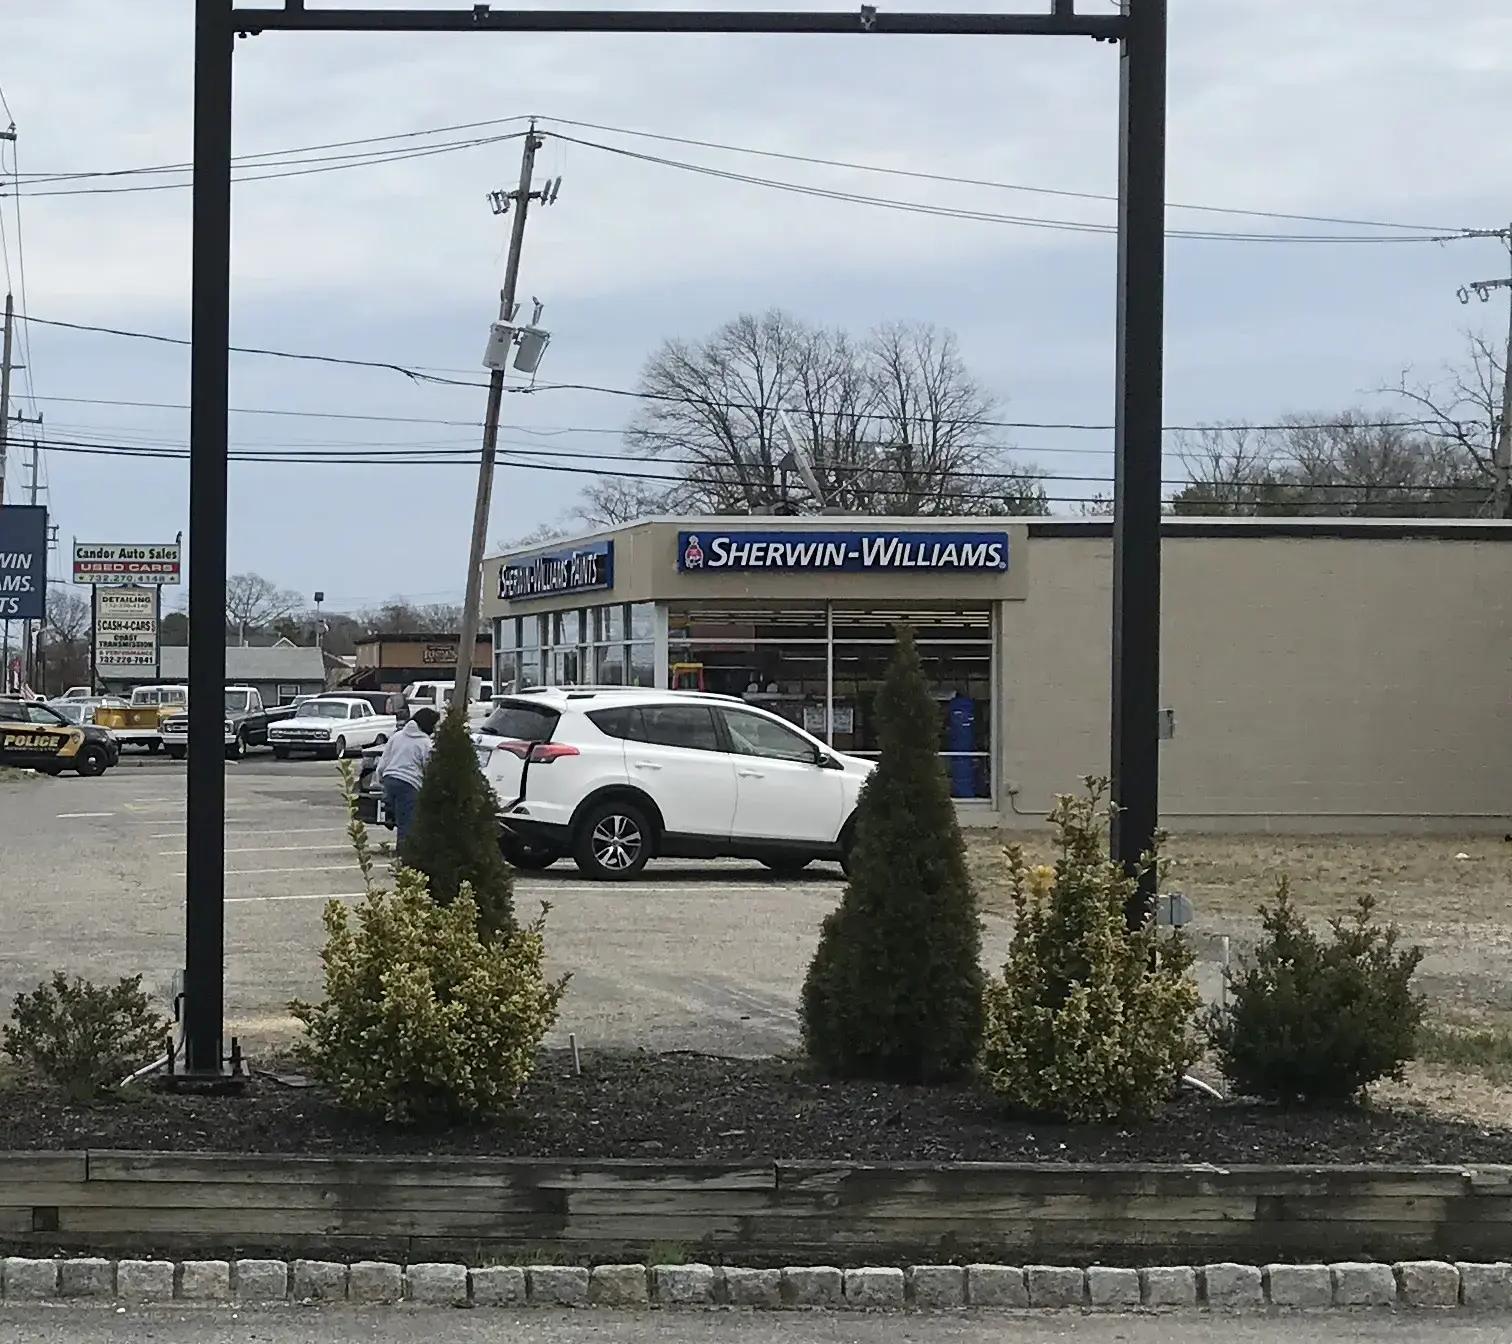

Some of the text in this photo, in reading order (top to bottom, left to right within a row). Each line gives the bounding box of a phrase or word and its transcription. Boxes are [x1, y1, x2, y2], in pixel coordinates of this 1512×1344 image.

[118, 548, 146, 559] Auto
[149, 548, 178, 559] Sales
[707, 537, 1003, 568] SHERWIN-WILLIAMS
[80, 563, 174, 572] USED CARS
[98, 640, 154, 649] TRANSMISSION
[3, 735, 61, 747] POLICE
